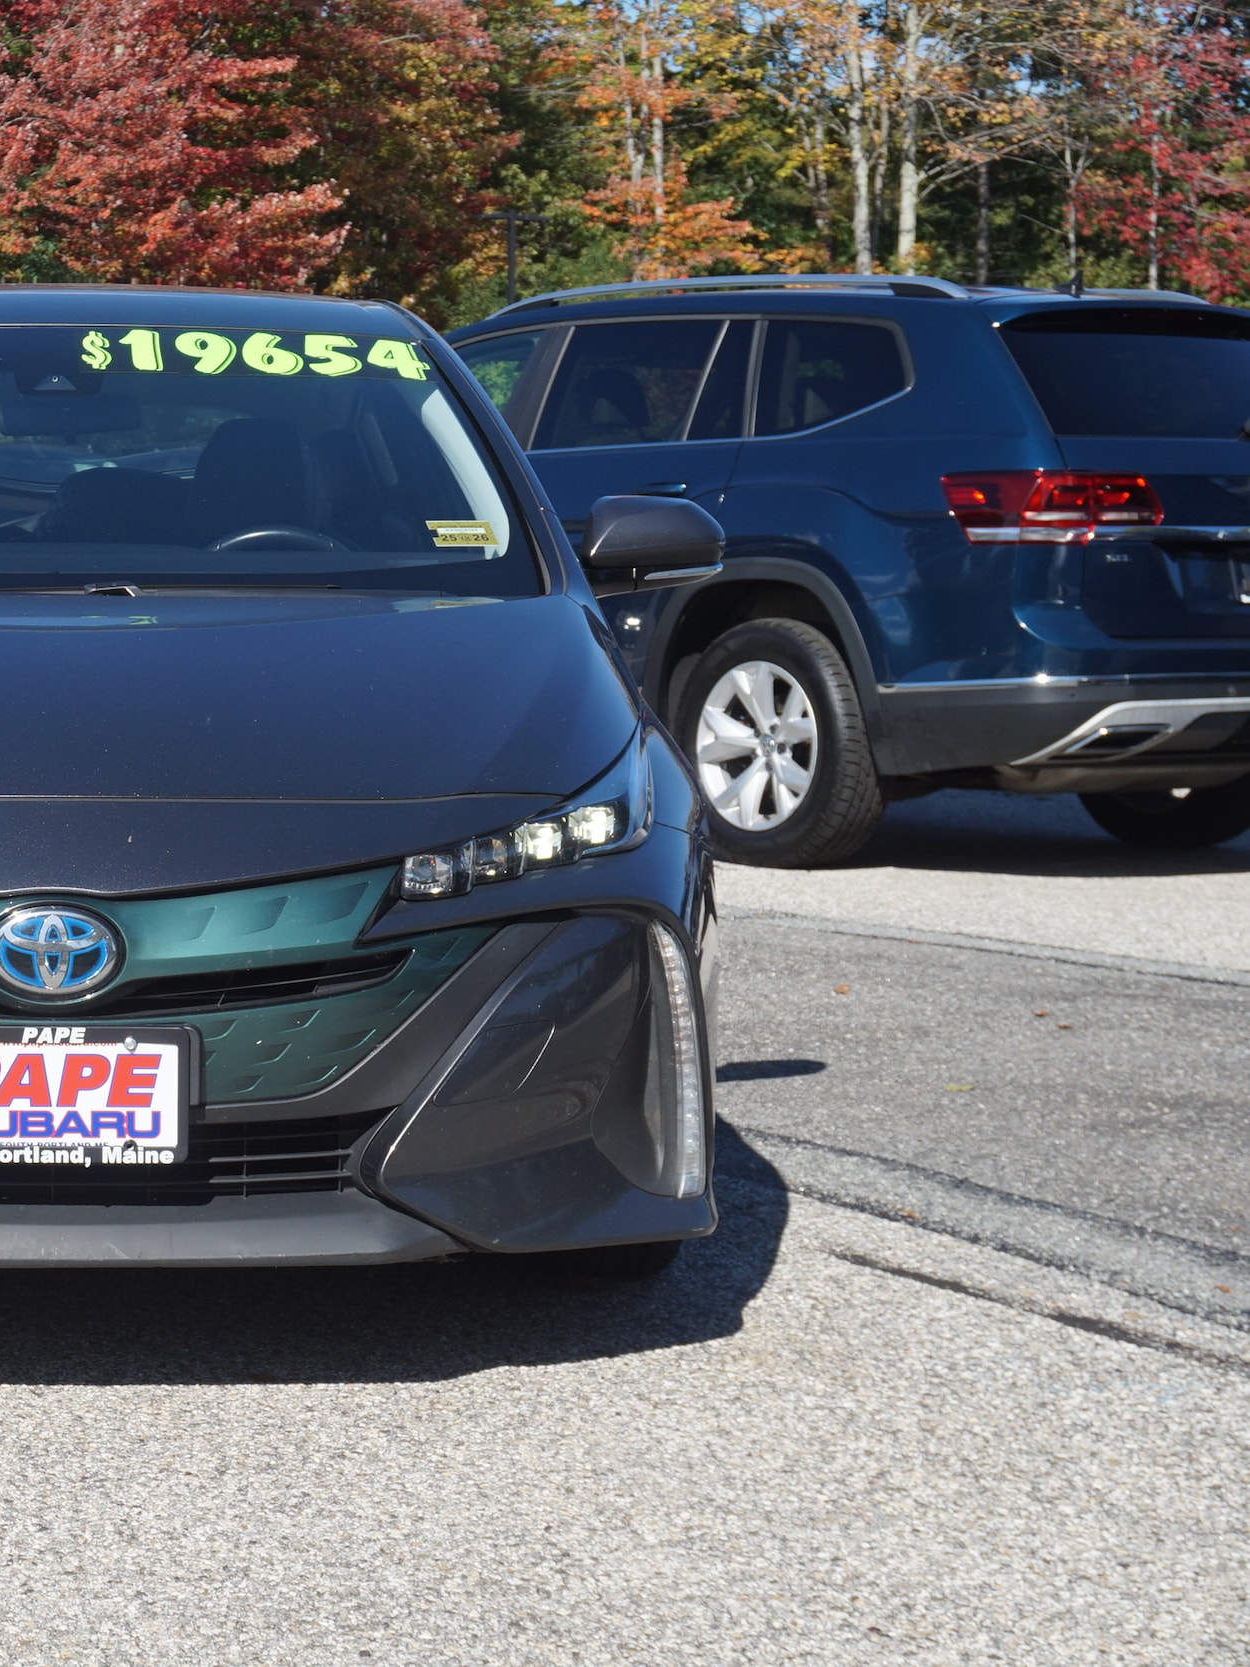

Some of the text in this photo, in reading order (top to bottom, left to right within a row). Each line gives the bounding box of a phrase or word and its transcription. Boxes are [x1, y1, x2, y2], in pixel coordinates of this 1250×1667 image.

[81, 329, 431, 381] $19654
[440, 534, 458, 542] 25
[472, 534, 489, 542] 26
[21, 1027, 87, 1044] PAPE
[102, 1146, 174, 1164] Maine
